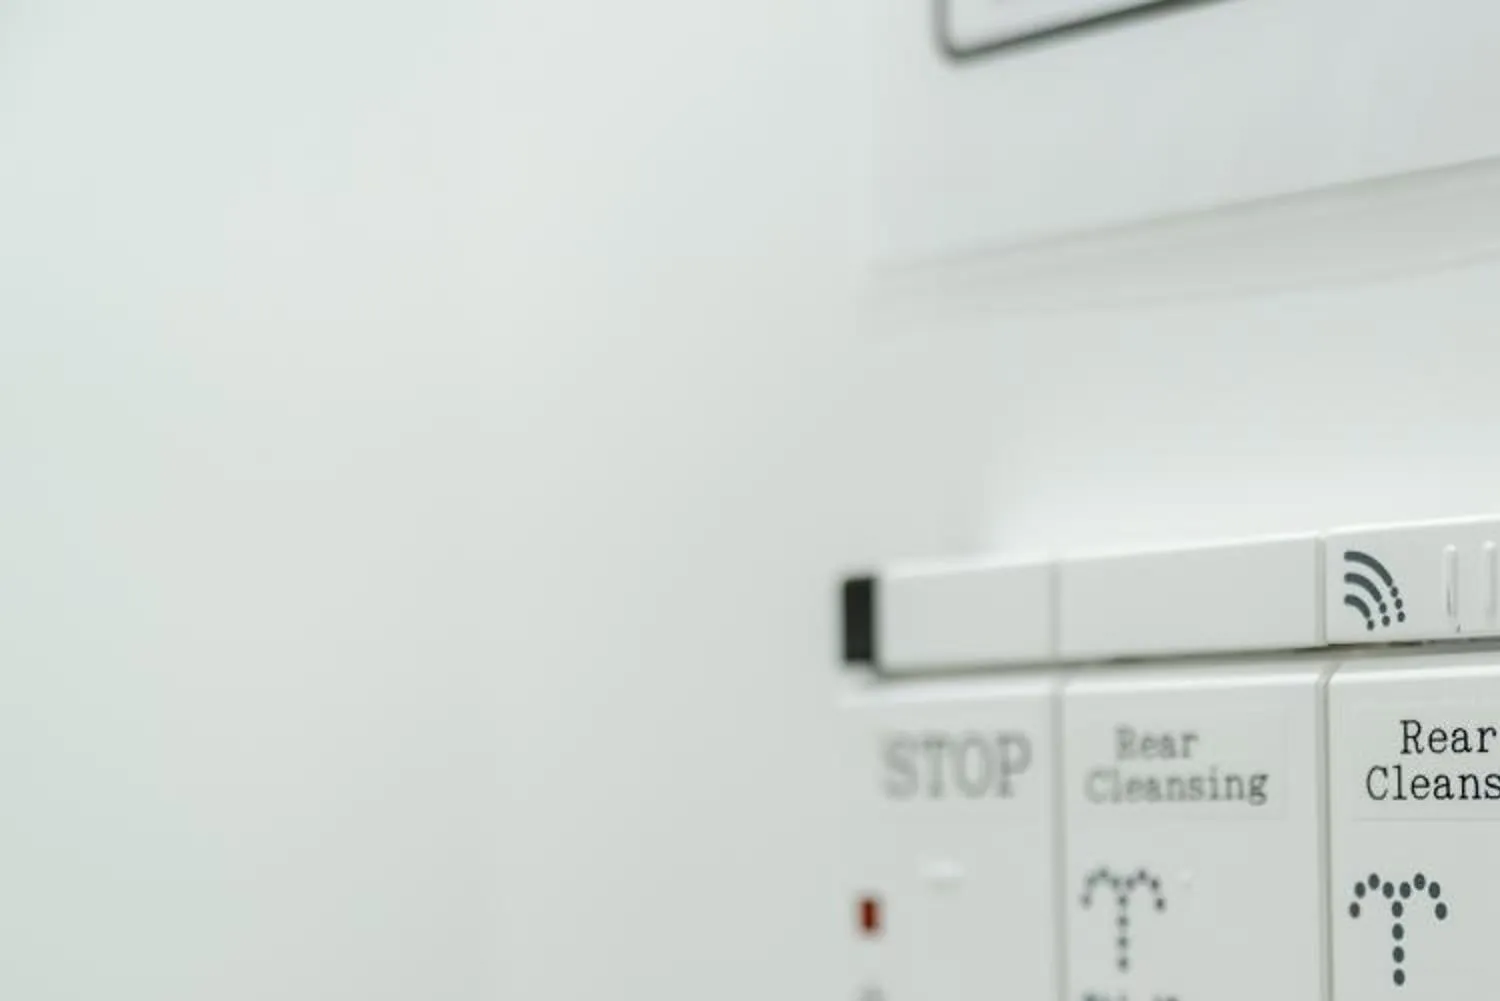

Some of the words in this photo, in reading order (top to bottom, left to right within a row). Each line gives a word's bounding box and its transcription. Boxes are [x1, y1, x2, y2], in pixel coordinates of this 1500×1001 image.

[1115, 724, 1201, 760] Rear
[1399, 718, 1499, 756] Rear
[882, 730, 1034, 801] STOP
[1083, 766, 1270, 807] Cleansing
